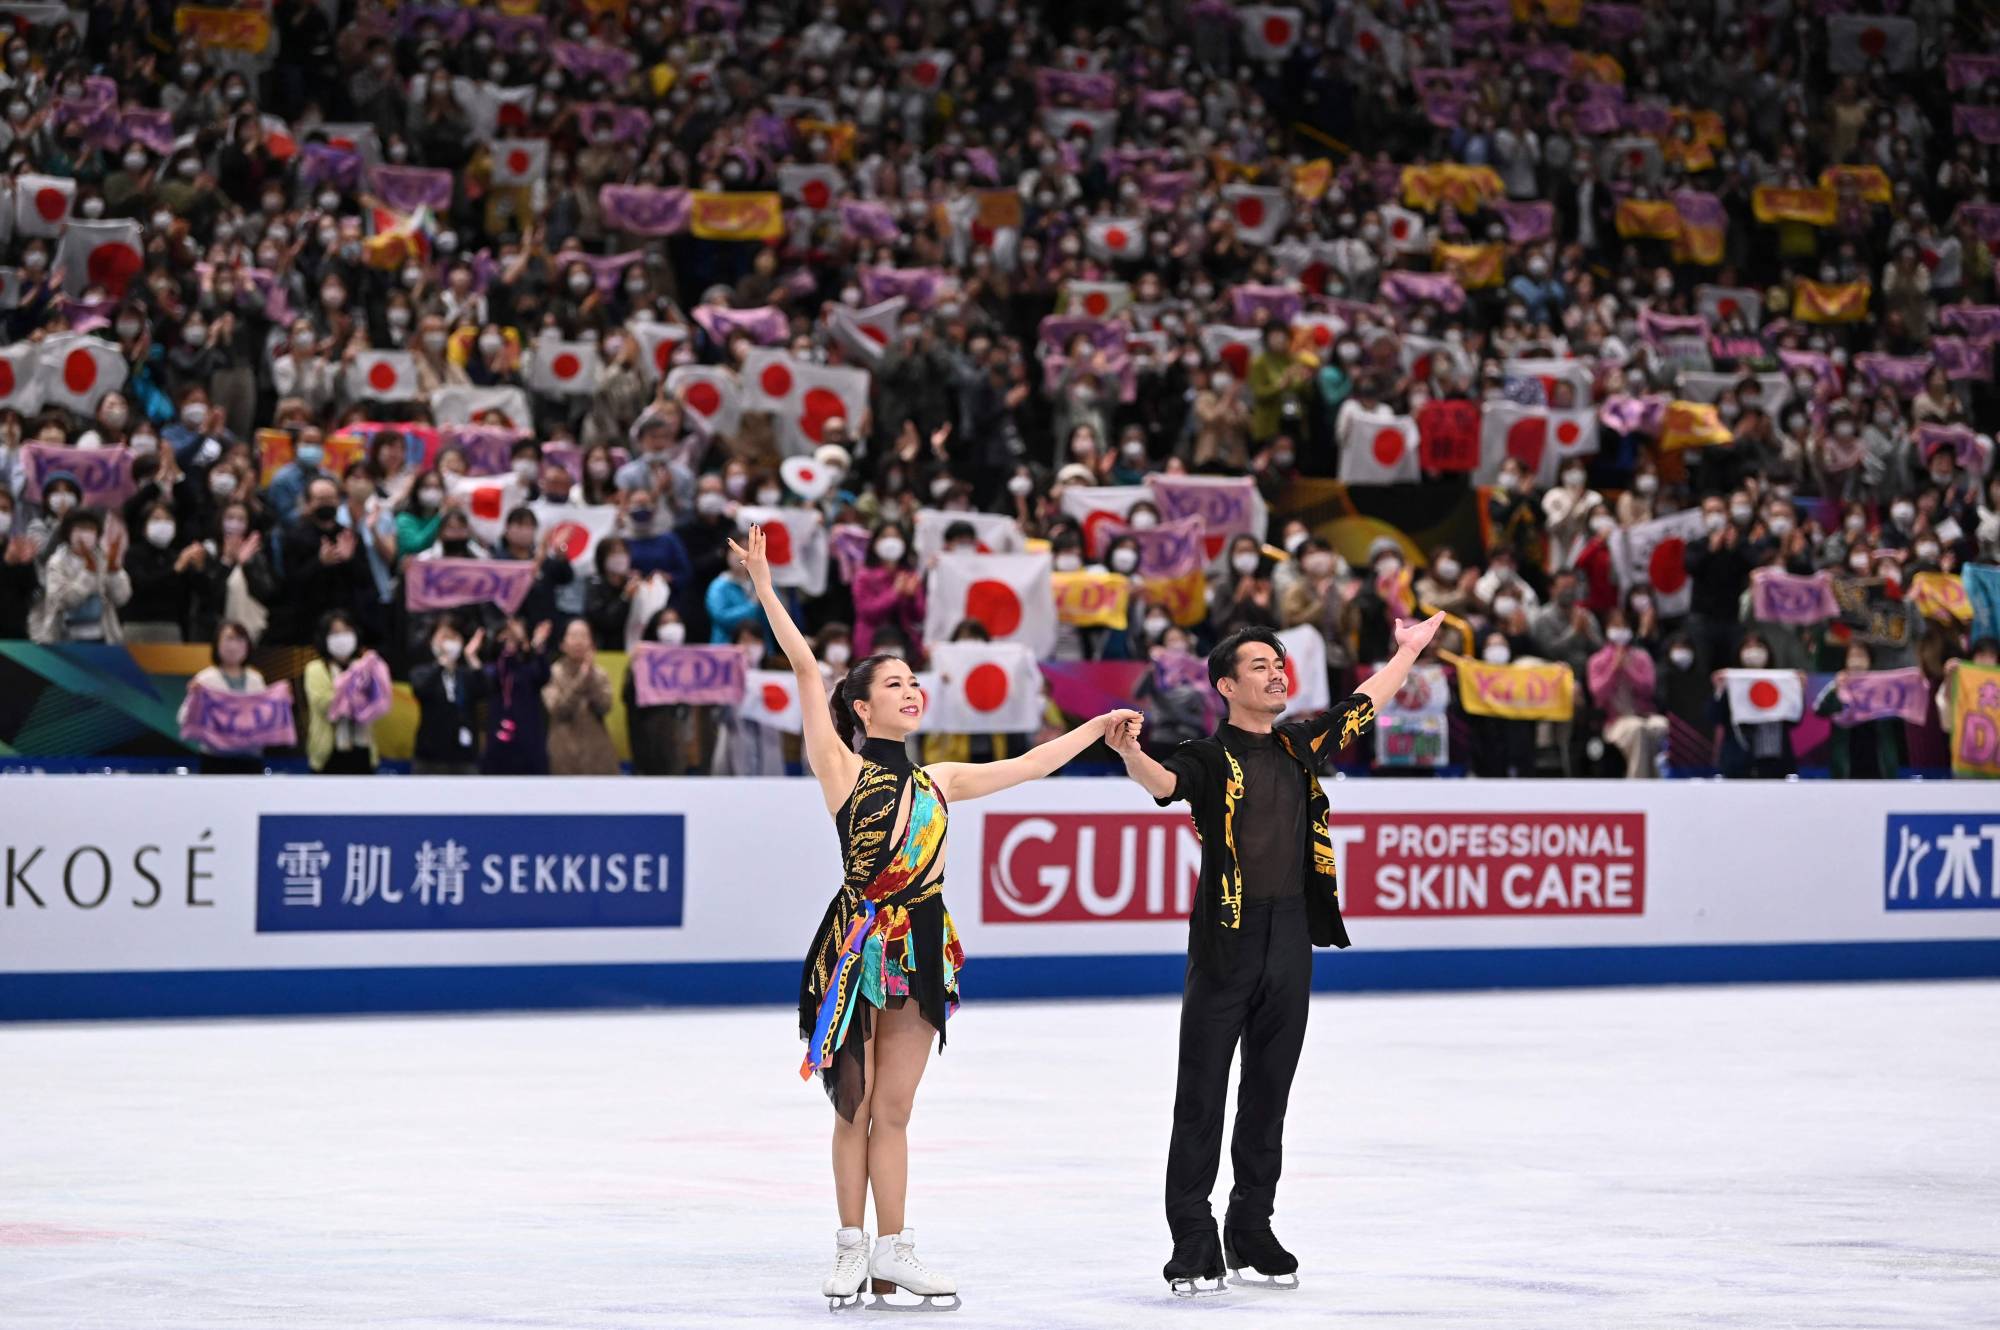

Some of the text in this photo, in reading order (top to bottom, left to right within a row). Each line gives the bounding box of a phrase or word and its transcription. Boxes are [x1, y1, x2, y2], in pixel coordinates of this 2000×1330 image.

[6, 828, 215, 909] KOSÉ
[277, 838, 669, 907] 雪肌精 SEKKISEI
[990, 818, 1365, 916] GUINT
[1376, 823, 1634, 858] PROFESSIONAL
[1375, 863, 1634, 910] SKIN CARE
